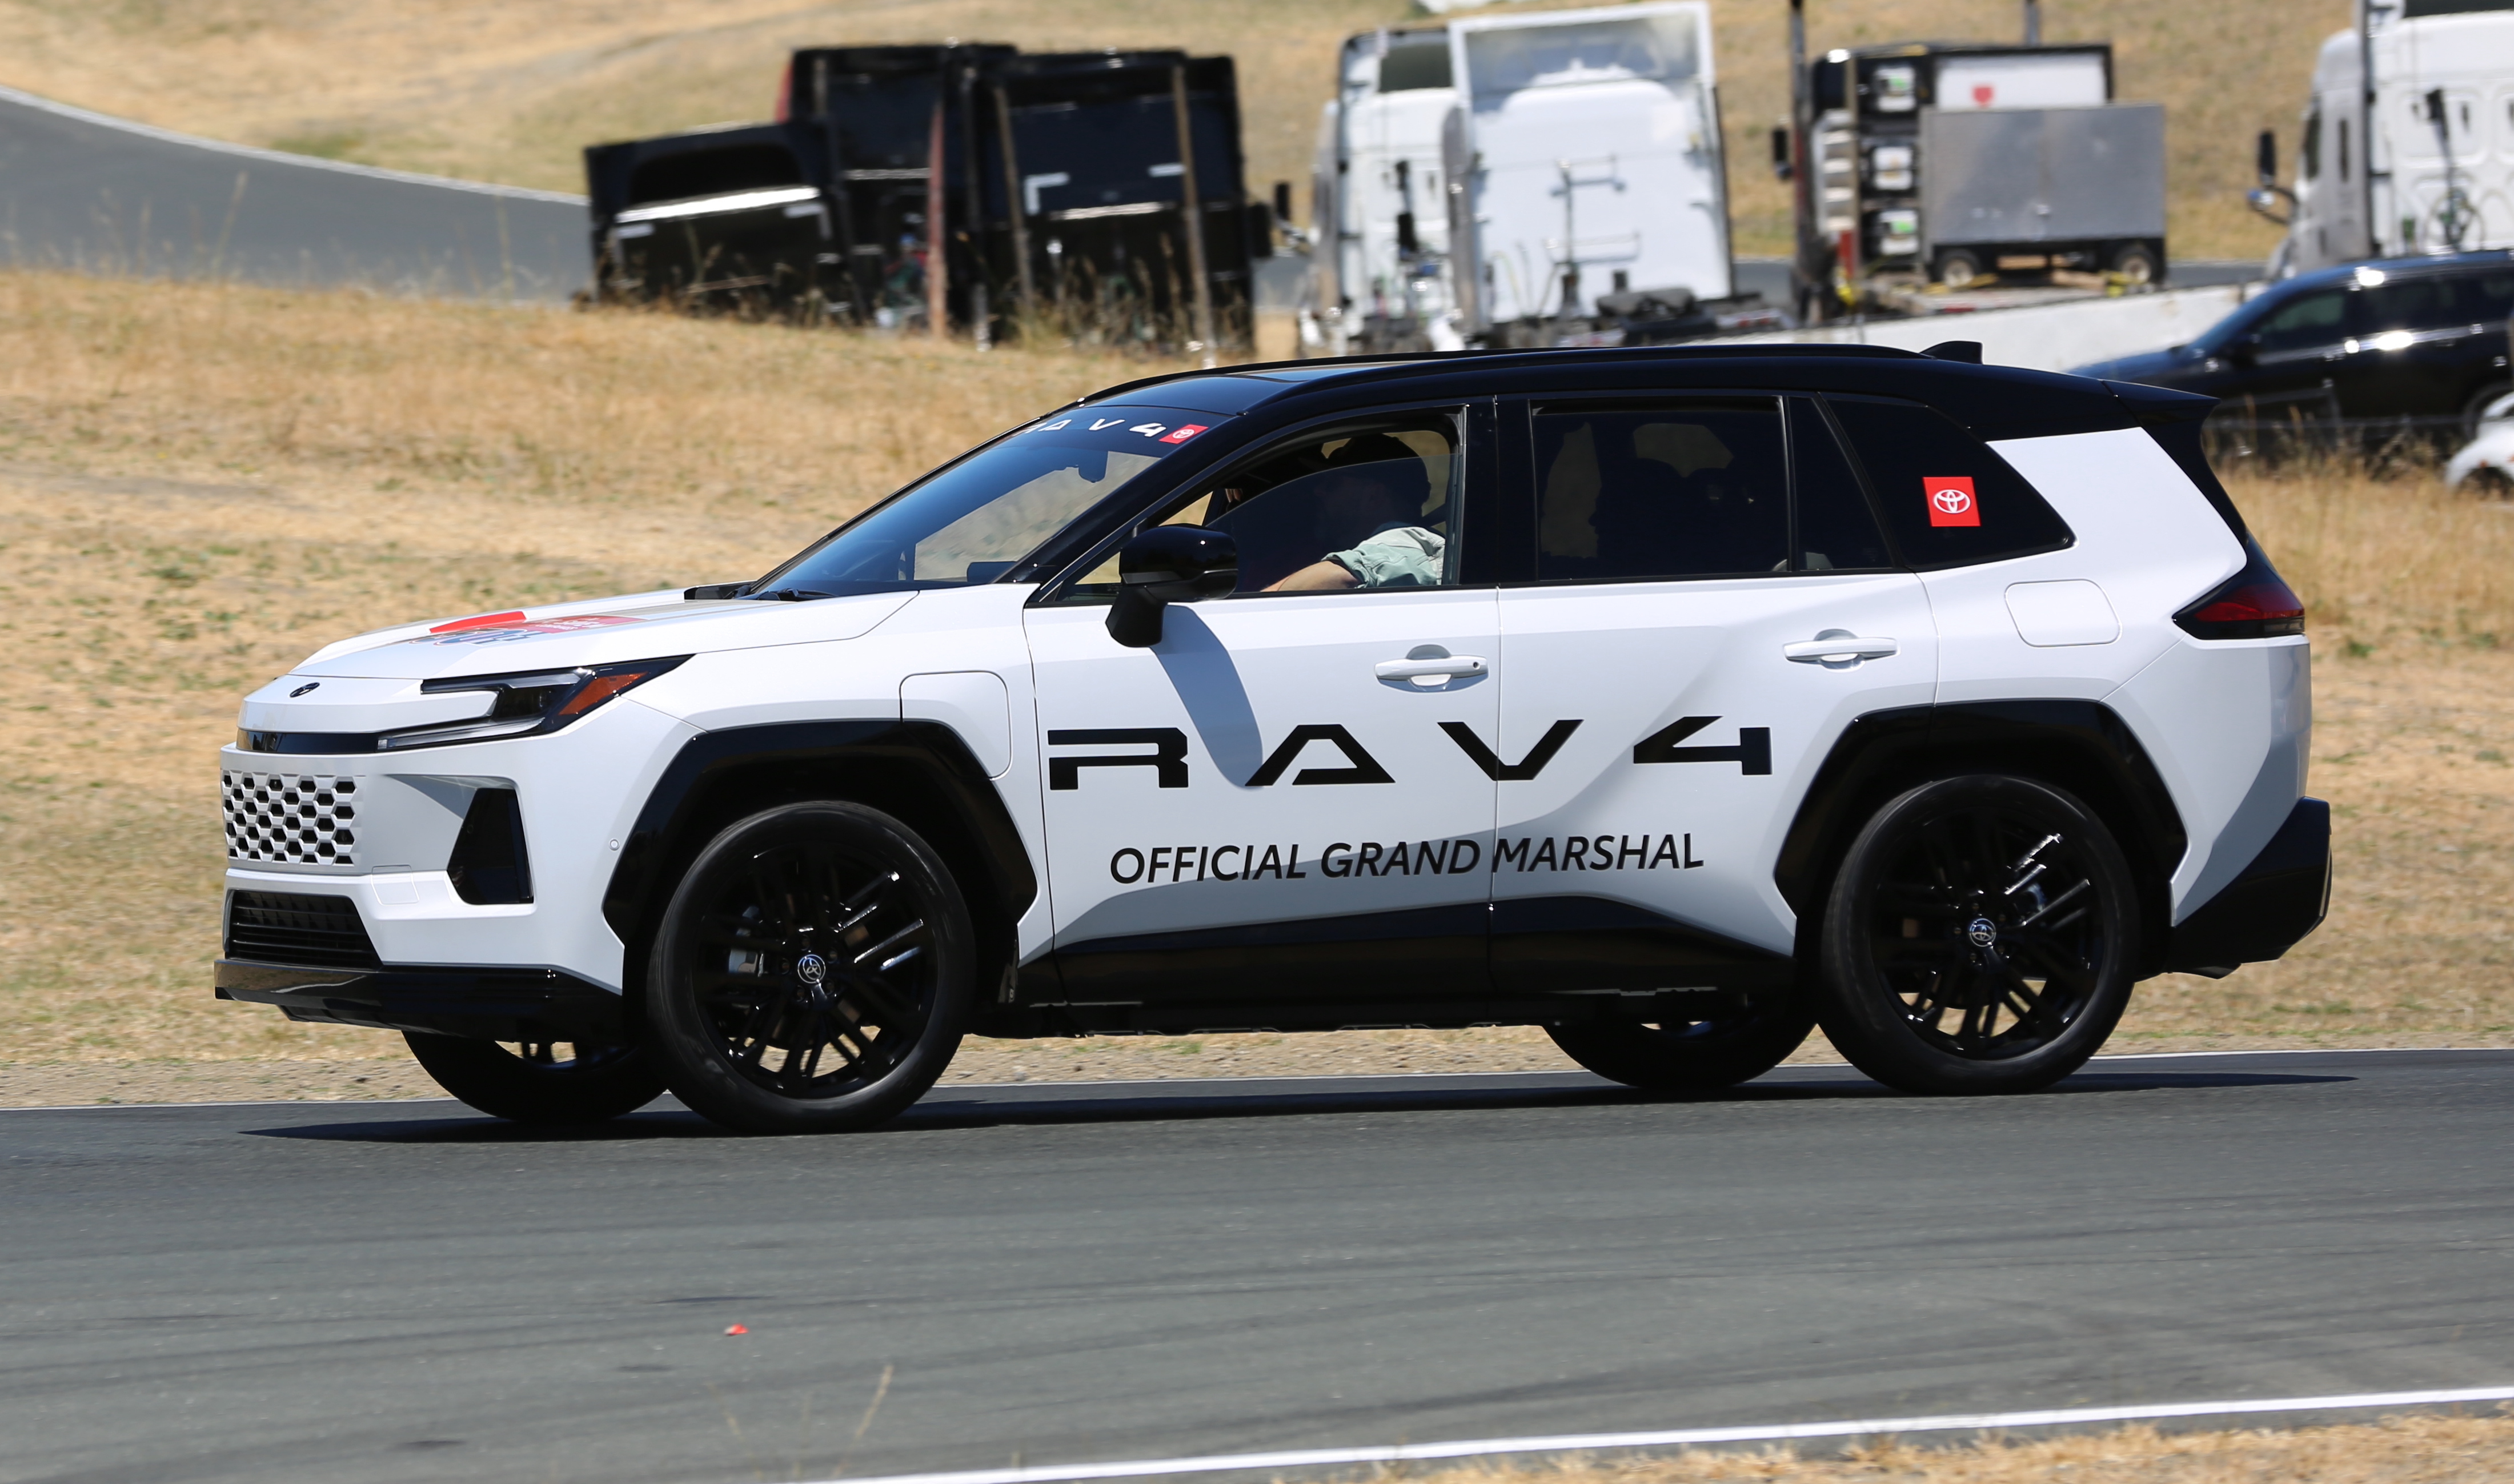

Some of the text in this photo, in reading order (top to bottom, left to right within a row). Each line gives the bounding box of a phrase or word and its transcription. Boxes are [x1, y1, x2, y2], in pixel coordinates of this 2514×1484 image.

[1047, 716, 1772, 791] RAV4
[1110, 833, 1704, 884] OFFICIAL GRAND MARSHAL
